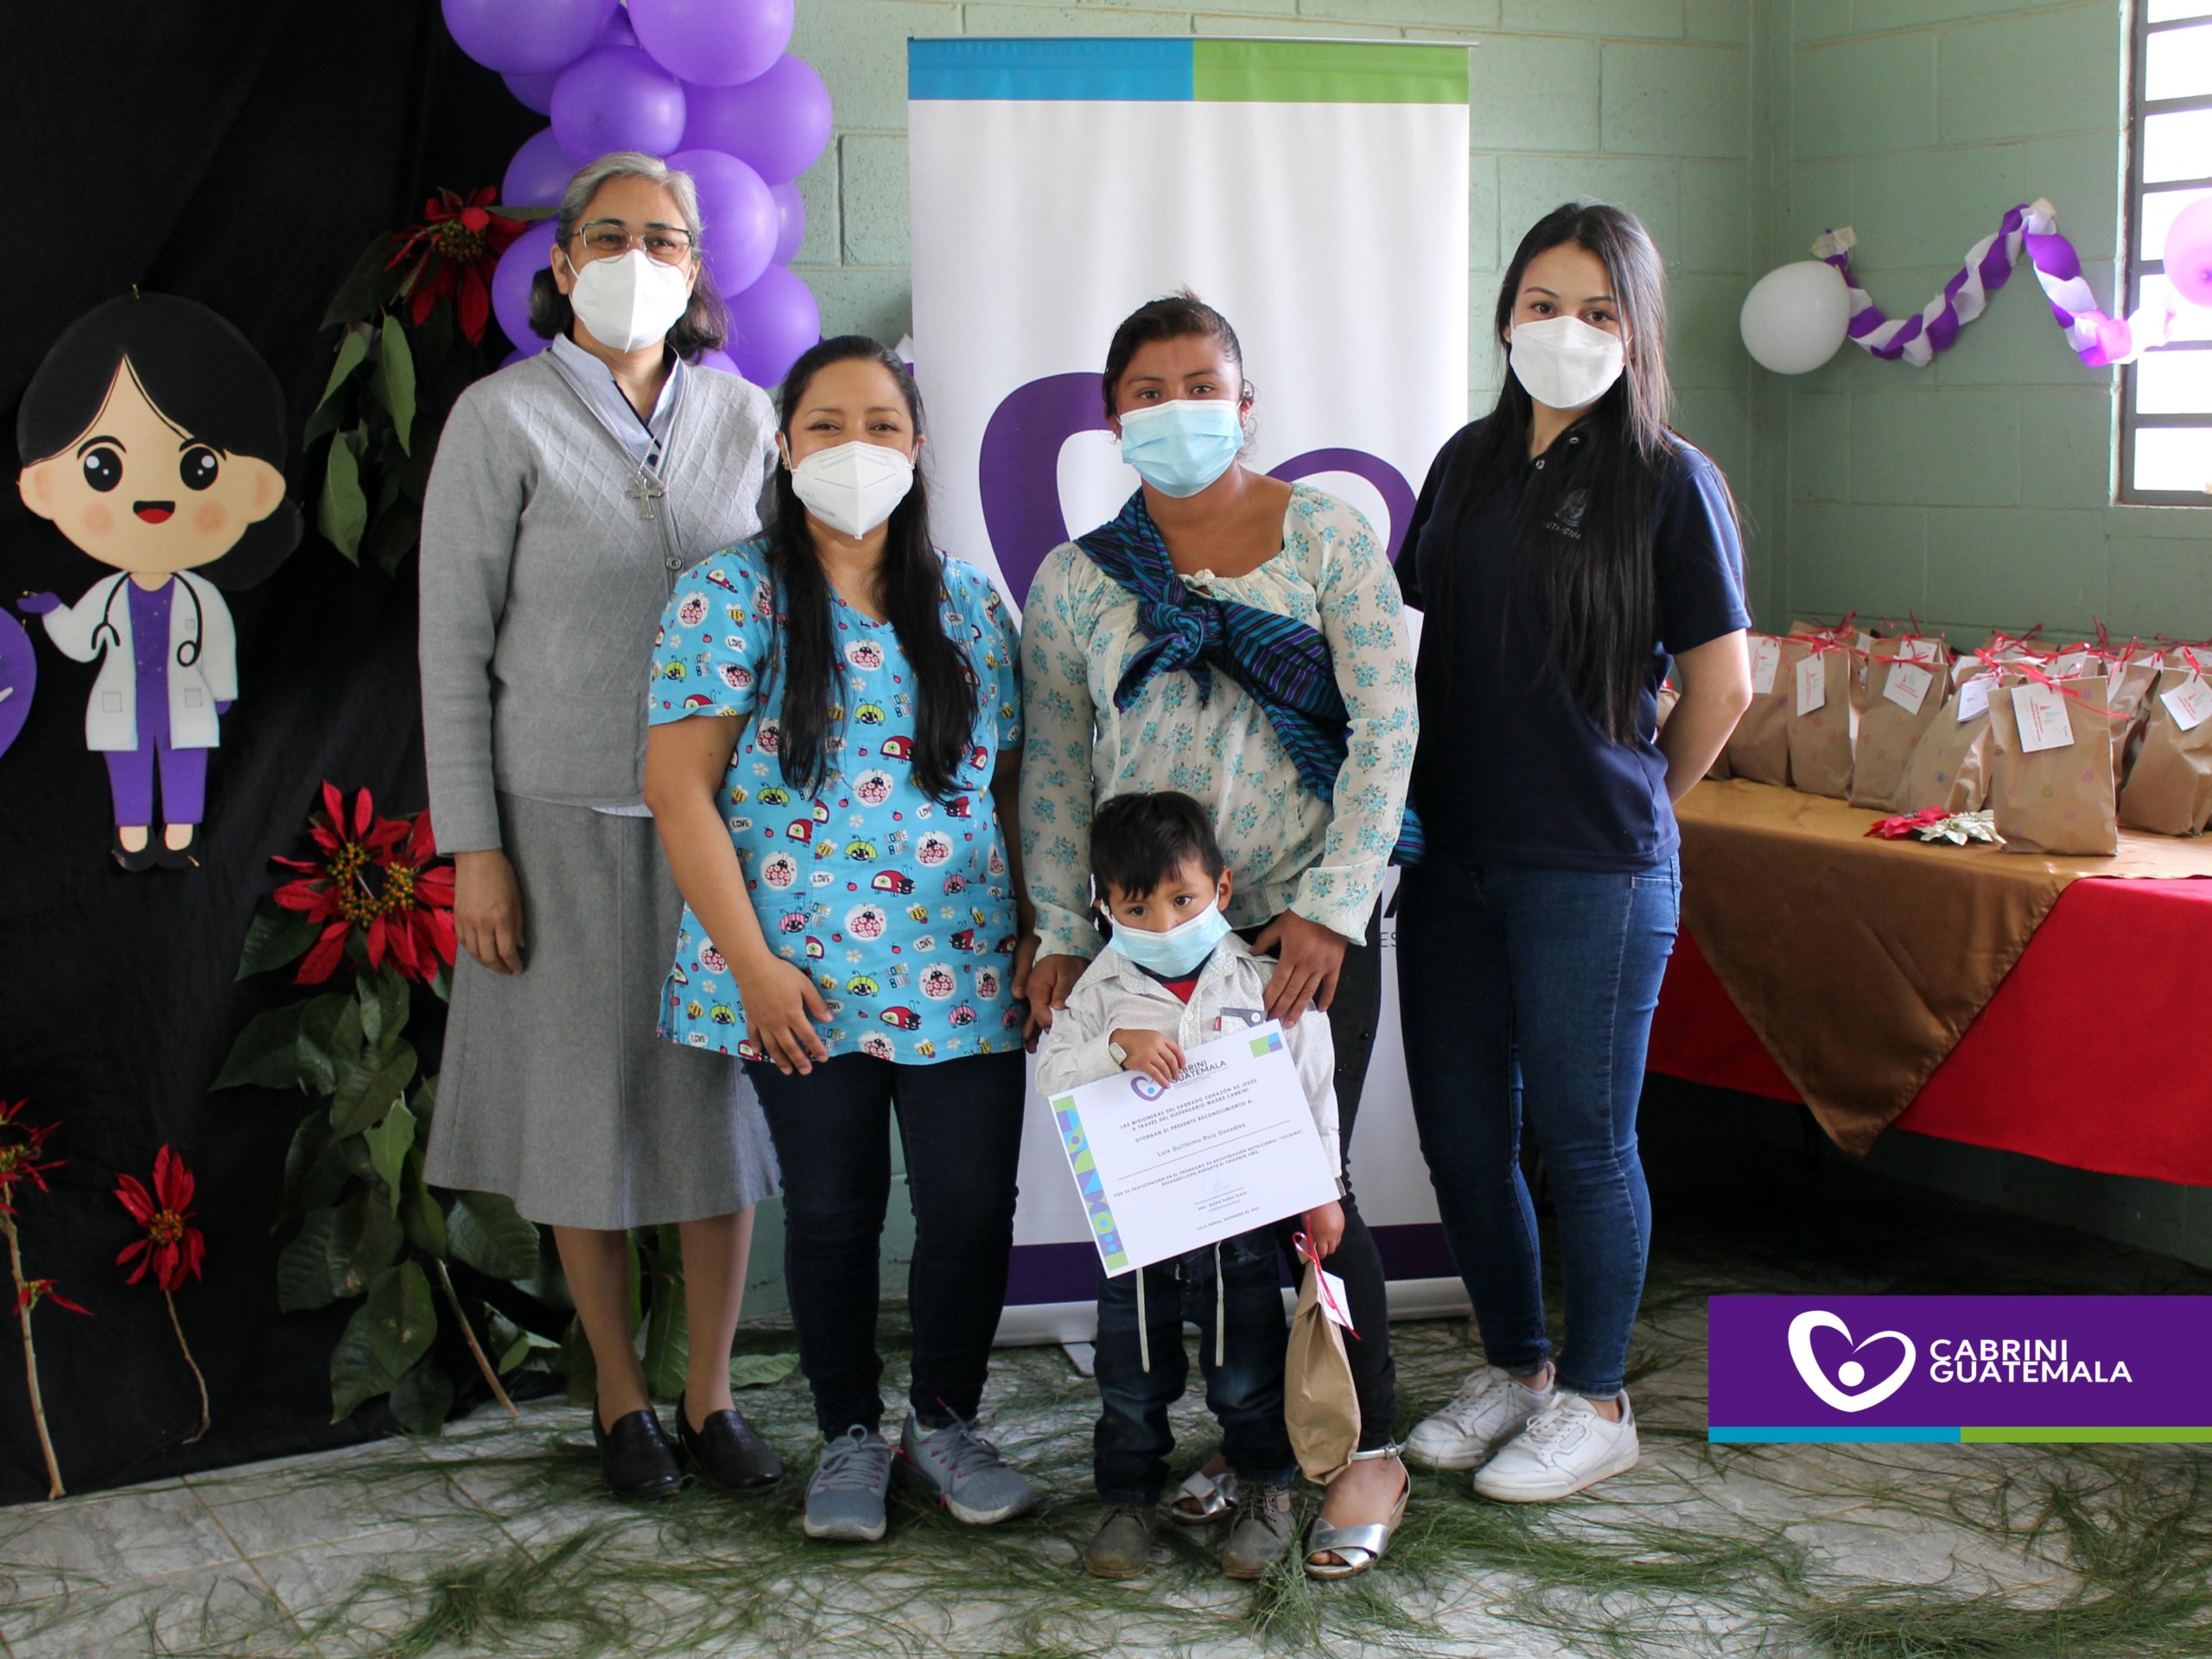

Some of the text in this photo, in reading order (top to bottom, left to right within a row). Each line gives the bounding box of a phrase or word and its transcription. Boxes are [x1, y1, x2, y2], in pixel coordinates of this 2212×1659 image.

[728, 639, 743, 650] LOVE
[884, 829, 908, 844] LOVE
[887, 842, 909, 855] BUG
[806, 901, 832, 917] LOVE
[916, 938, 933, 950] LOVE
[885, 962, 908, 978] LOVE
[889, 974, 912, 988] BUG
